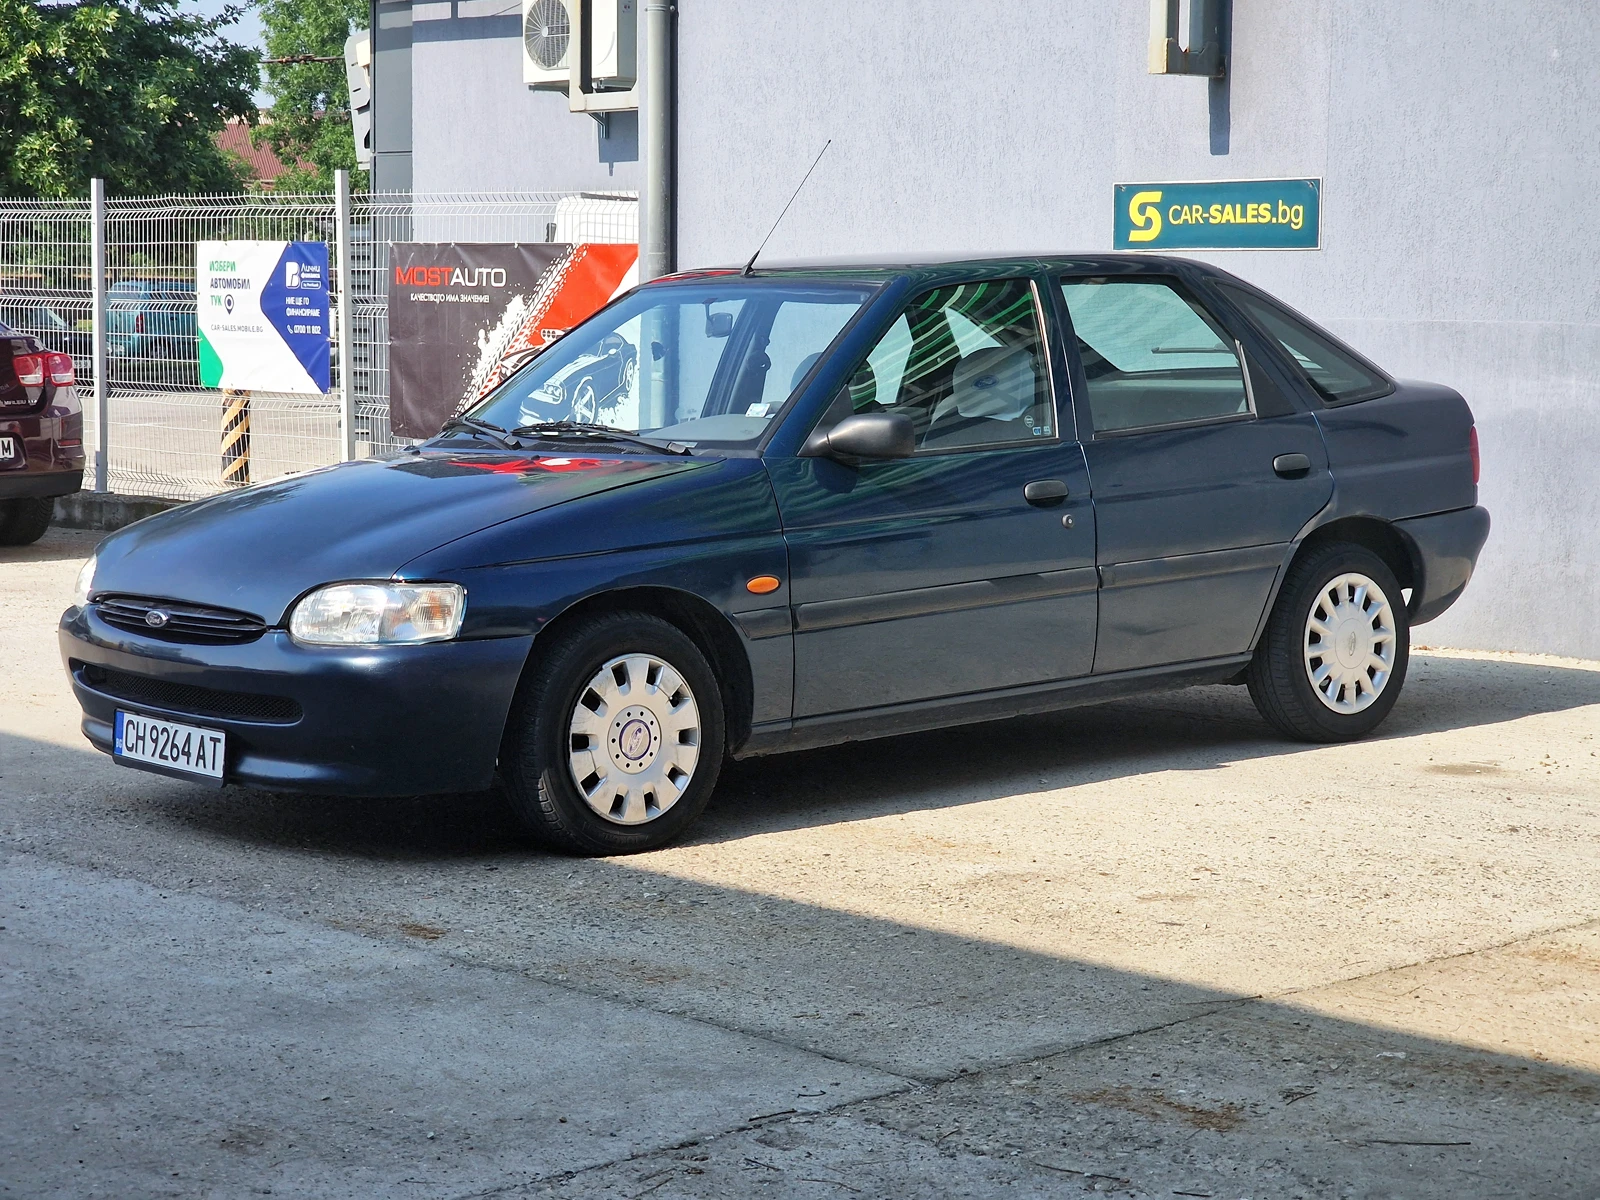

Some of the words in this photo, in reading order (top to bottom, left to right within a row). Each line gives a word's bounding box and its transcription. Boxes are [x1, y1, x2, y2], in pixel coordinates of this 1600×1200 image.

[1168, 199, 1304, 230] CAR-SALES.bg
[209, 260, 236, 272] ИЗБЕРИ
[301, 263, 321, 273] Лични
[395, 266, 507, 288] MOSTAUTO
[209, 278, 250, 290] АВТОМОБИЛ
[210, 295, 222, 306] ТУК
[410, 293, 445, 304] КАЧЕСТВОТО
[445, 294, 459, 303] ИМА
[210, 324, 264, 333] CAR-SALES.MOBILE.BG
